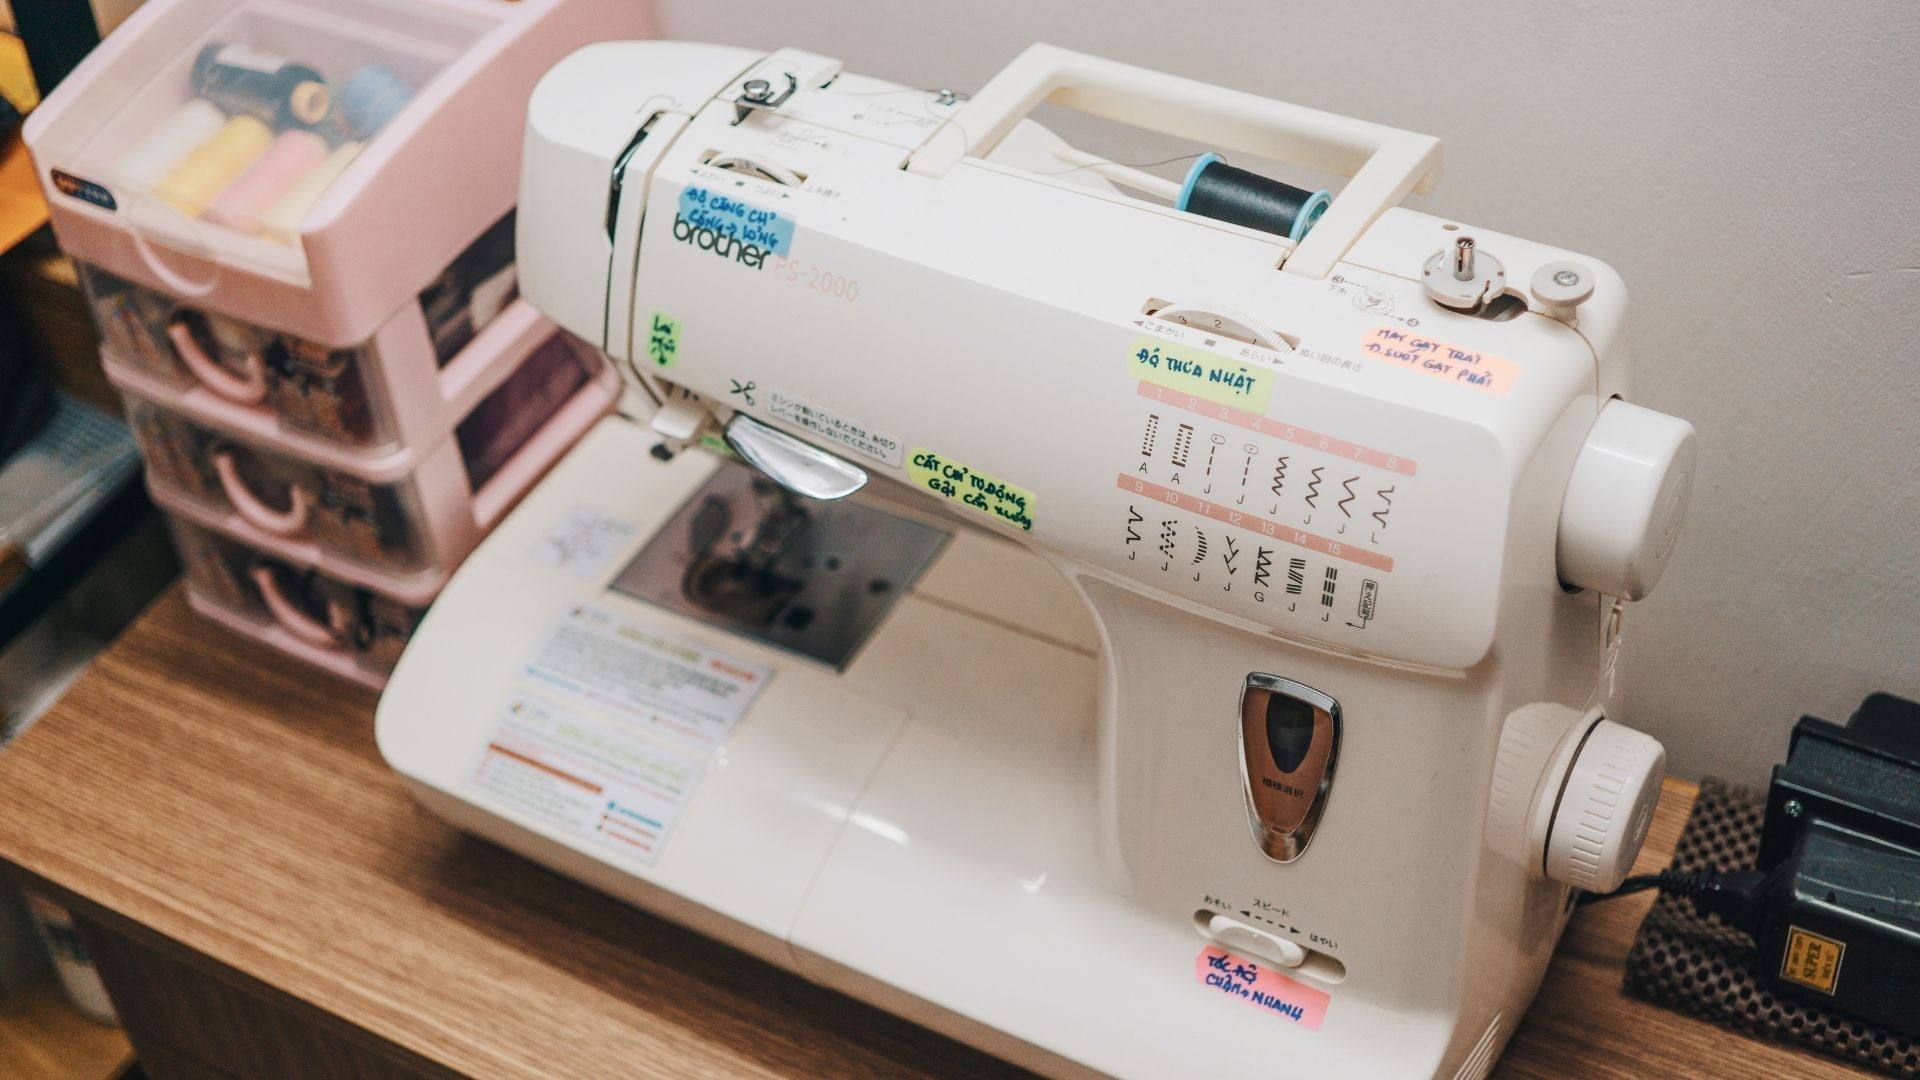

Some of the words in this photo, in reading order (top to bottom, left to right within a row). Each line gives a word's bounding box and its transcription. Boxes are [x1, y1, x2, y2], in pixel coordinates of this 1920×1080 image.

[673, 212, 771, 270] brother
[773, 255, 859, 302] PS-2000
[1179, 315, 1187, 325] 3
[1215, 319, 1222, 328] 2
[1239, 348, 1271, 362] あらい
[1156, 388, 1163, 399] 1
[1187, 398, 1198, 410] 2
[1220, 408, 1229, 420] 3
[1252, 419, 1261, 430] 4
[1285, 427, 1295, 440] 5
[1319, 437, 1329, 449] 6
[1354, 448, 1363, 459] 7
[1387, 457, 1397, 469] 8
[1135, 480, 1144, 492] 9
[1165, 491, 1179, 504] 10
[1198, 501, 1211, 514] 11
[1228, 511, 1242, 523] 12
[1261, 522, 1275, 535] 13
[1293, 531, 1307, 545] 14
[1327, 542, 1341, 555] 15
[1138, 462, 1148, 474] A
[1171, 472, 1180, 485] A
[1203, 484, 1211, 494] J
[1236, 494, 1244, 504] J
[1270, 504, 1277, 515] J
[1304, 514, 1311, 524] J
[1338, 524, 1345, 534] J
[1128, 551, 1135, 560] J
[1161, 562, 1168, 572] J
[1193, 572, 1200, 582] J
[1224, 582, 1231, 592] J
[1254, 591, 1264, 603] G
[1288, 602, 1296, 612] J
[1322, 612, 1329, 622] J
[1253, 898, 1291, 917] スピード
[1309, 933, 1338, 949] はやい
[1251, 991, 1304, 1021] NHANH
